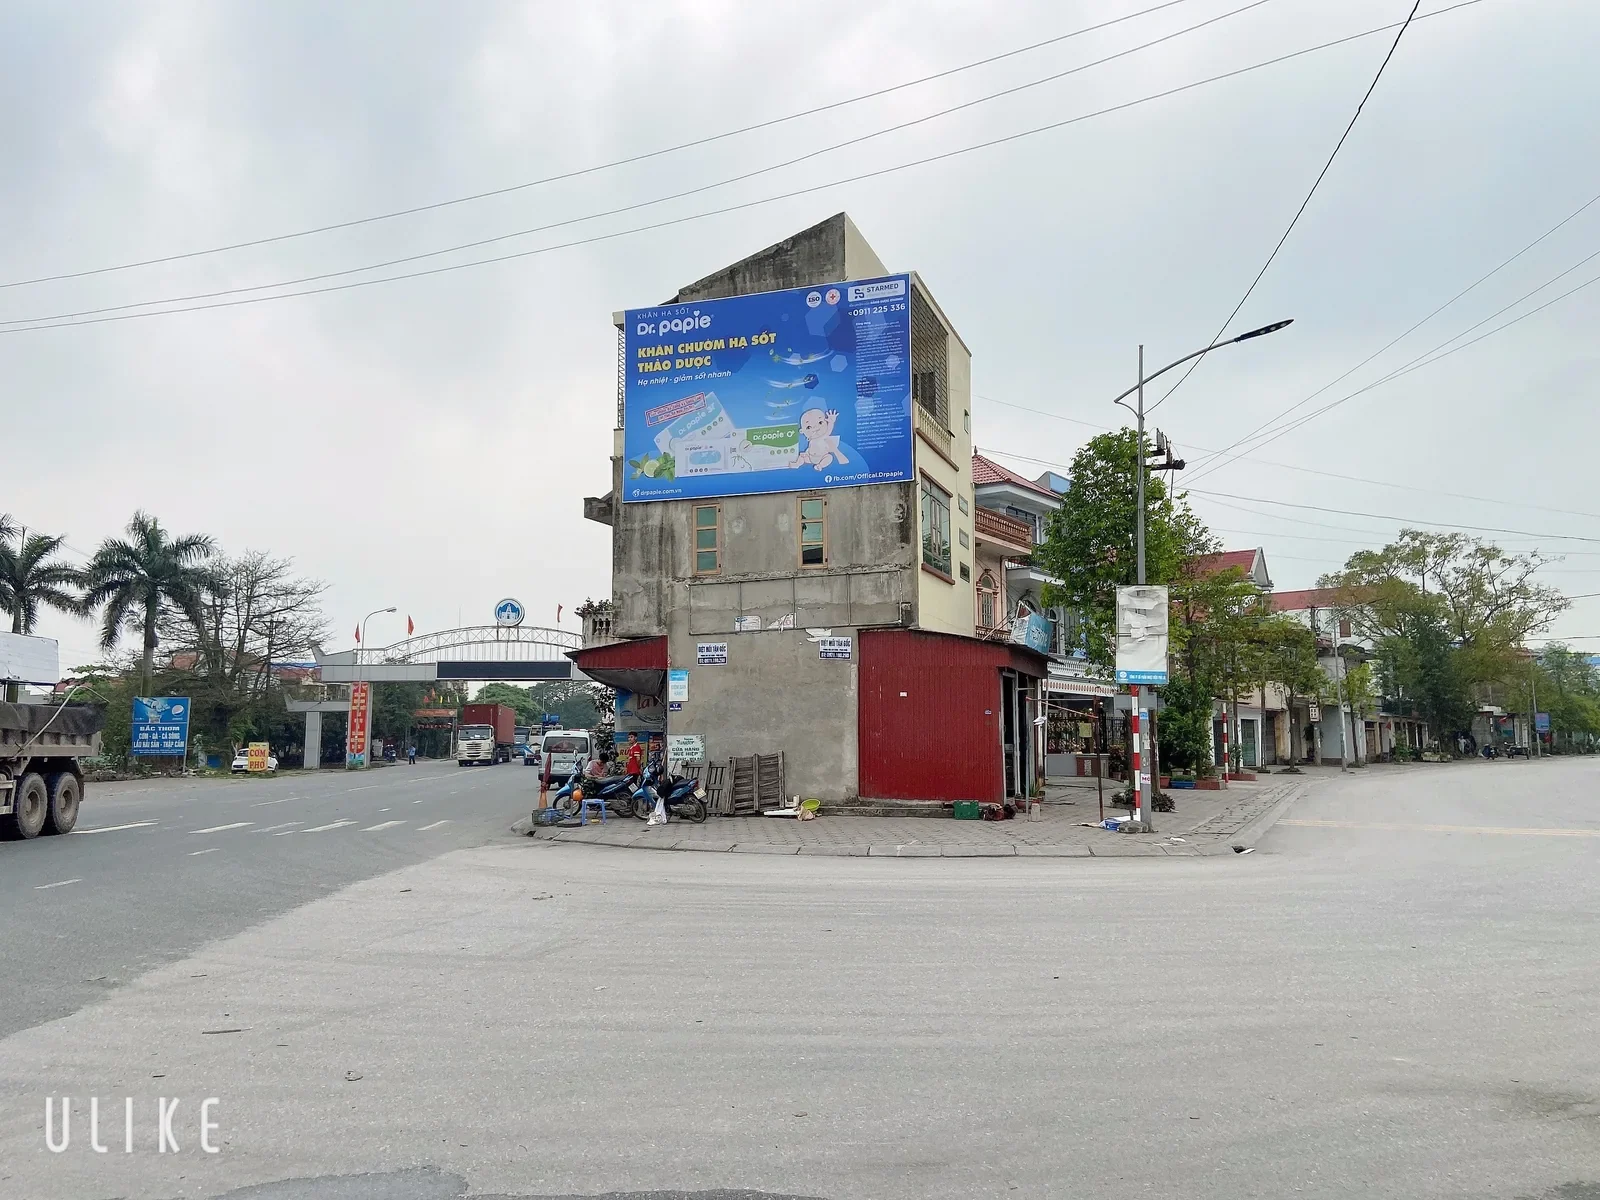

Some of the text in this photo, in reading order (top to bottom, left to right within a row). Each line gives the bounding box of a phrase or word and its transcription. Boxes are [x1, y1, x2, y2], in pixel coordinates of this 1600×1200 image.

[867, 283, 898, 293] STARMED
[675, 307, 690, 316] SỐT
[852, 303, 906, 316] 0911 225 336
[637, 310, 712, 336] Dr. papie
[637, 330, 777, 358] KHĂN CHƯỜM HẠ SỐT
[637, 355, 712, 373] THẢO DƯỢC
[638, 378, 648, 387] Hạ
[650, 375, 668, 385] nhiệt
[674, 373, 693, 384] giảm
[695, 370, 707, 380] sốt
[708, 370, 731, 379] nhanh
[762, 430, 784, 440] papie
